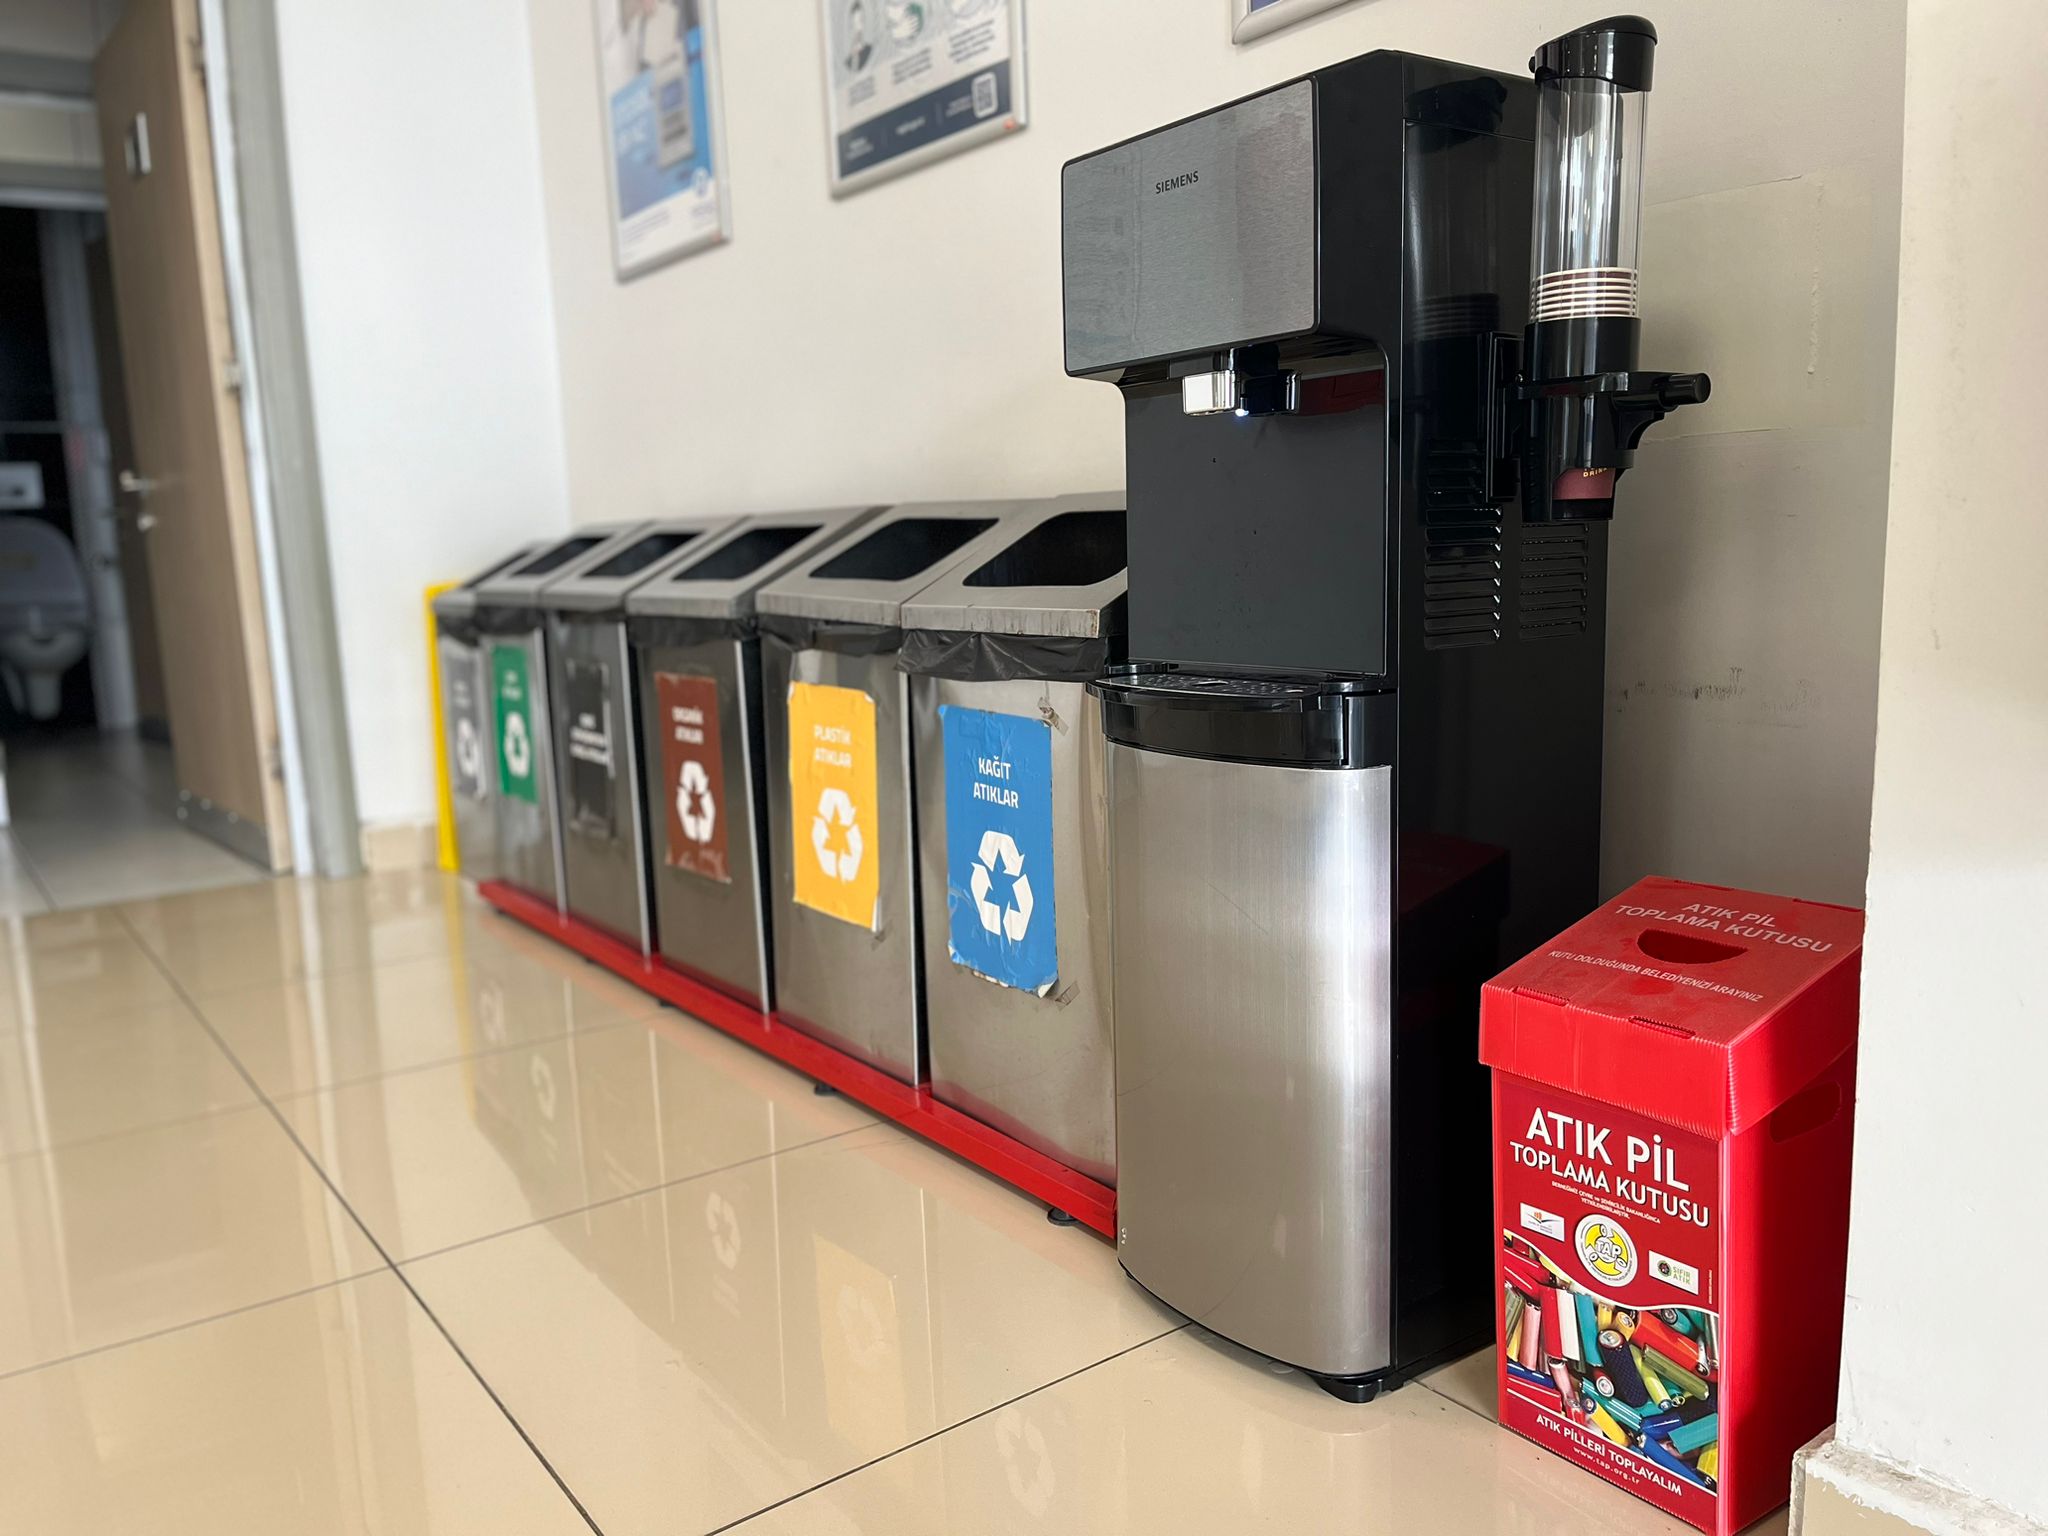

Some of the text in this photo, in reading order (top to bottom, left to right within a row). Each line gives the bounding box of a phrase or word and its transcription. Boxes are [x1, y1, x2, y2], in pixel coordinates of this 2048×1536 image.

[1155, 170, 1199, 195] SIEMENS
[813, 723, 852, 745] PLASTİK
[814, 746, 853, 769] ATIKLAR
[978, 755, 1012, 780] KAĞIT
[973, 781, 1019, 809] ATIKLAR
[1615, 905, 1833, 953] TOPLAMA KUTUSU
[1682, 903, 1777, 928] ATIK PİL
[1549, 950, 1764, 1002] KUTU DOLDUĞUNDA BELEDİYENİZİ ARAYINIZ
[1526, 1106, 1690, 1192] ATIK PİL
[1509, 1140, 1710, 1228] TOPLAMA KUTUSU
[1595, 1240, 1622, 1259] TAP
[1536, 1413, 1683, 1497] ATIK PİLLERİ TOPLAYALIM
[1572, 1446, 1641, 1485] www.tap.org.tr
